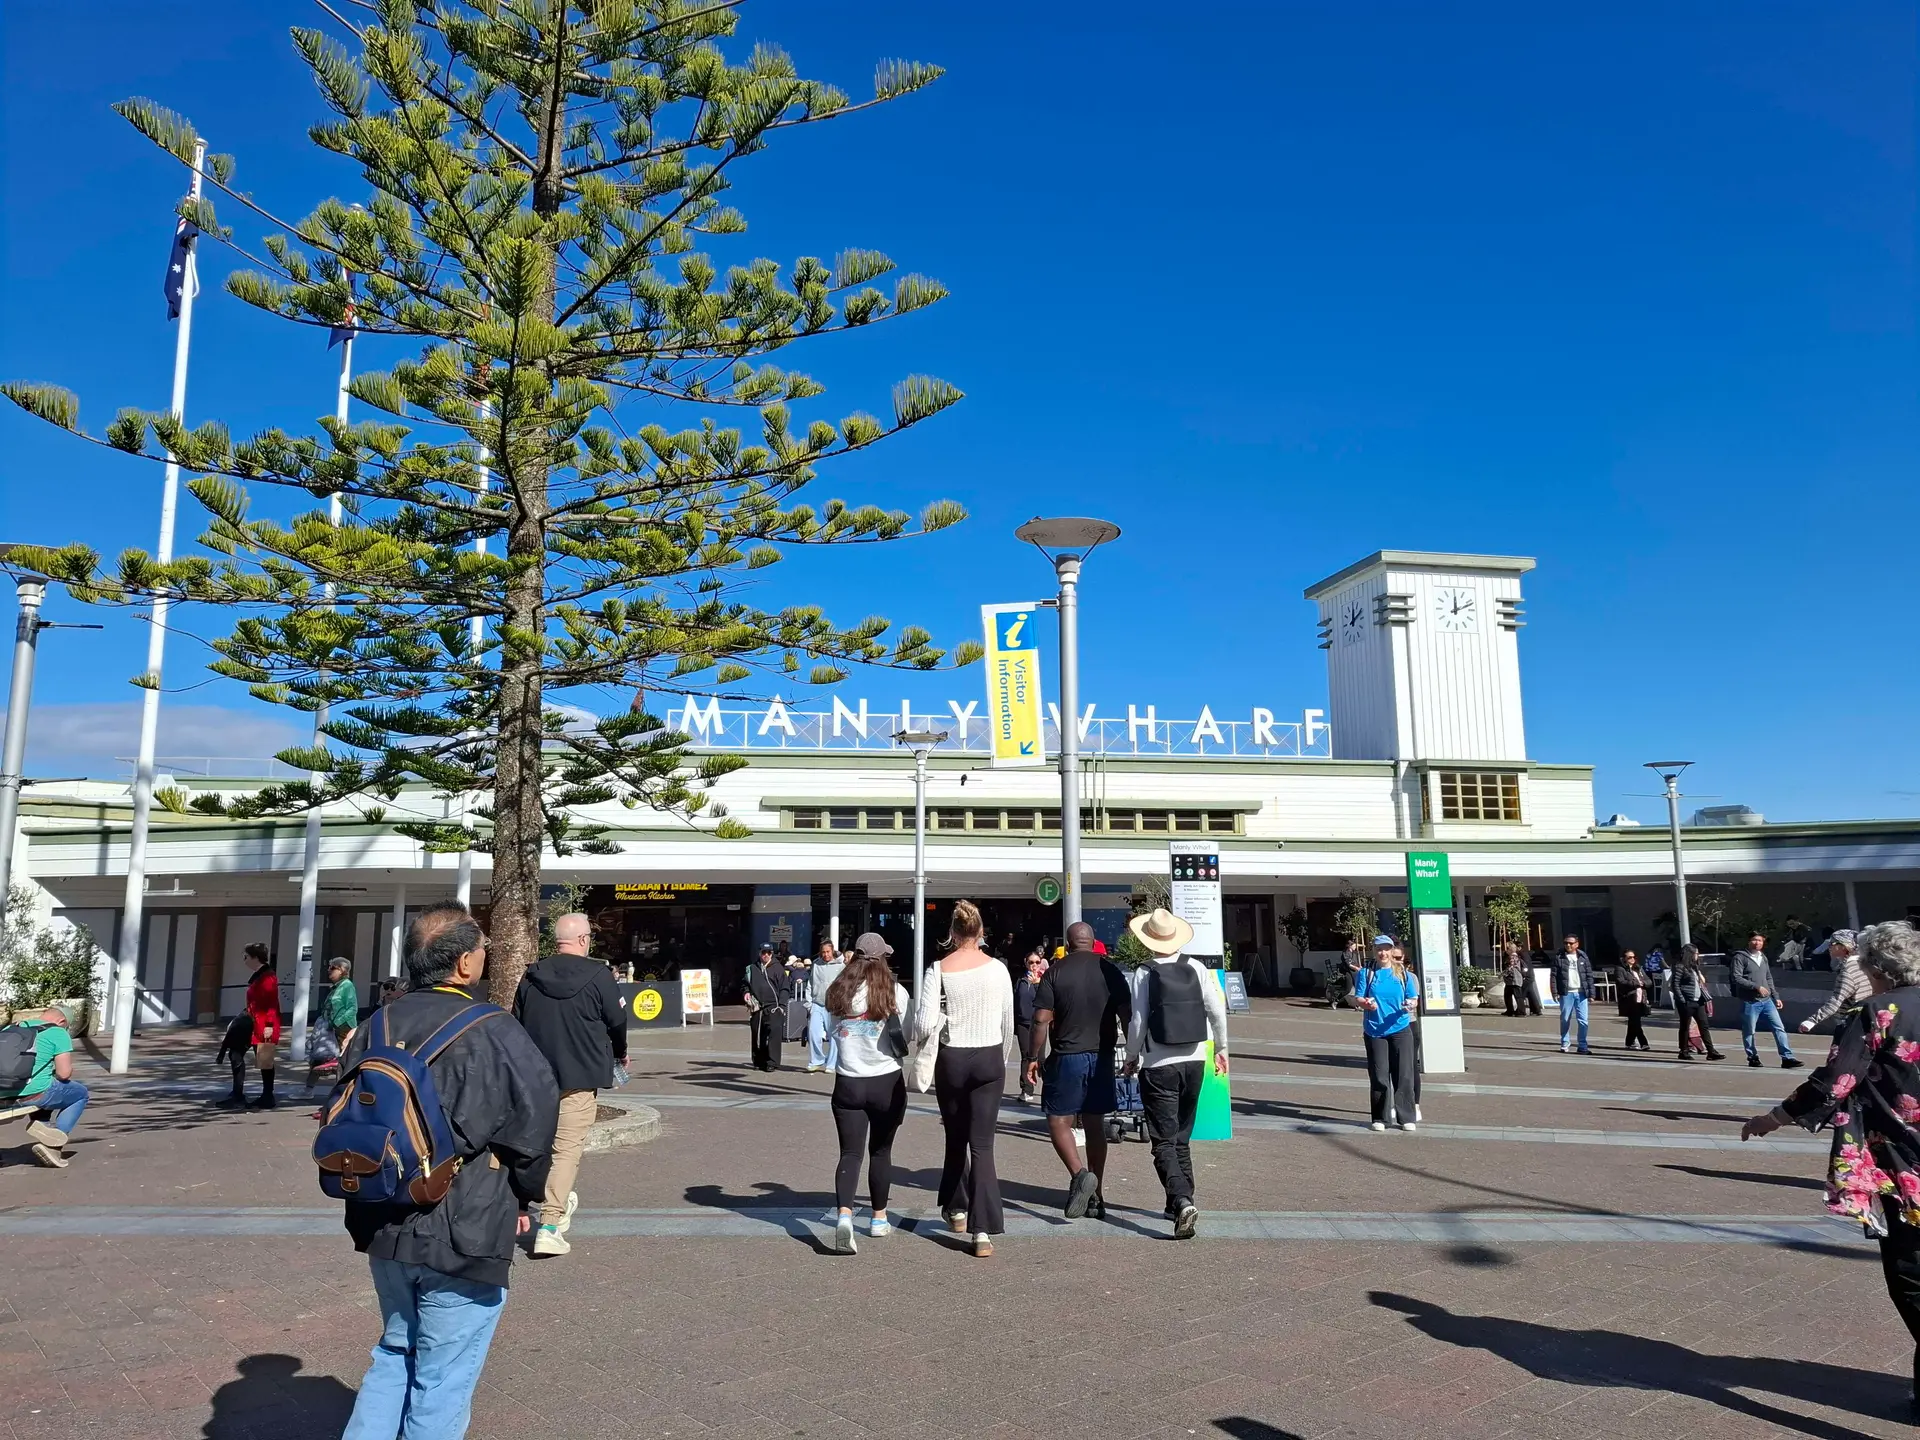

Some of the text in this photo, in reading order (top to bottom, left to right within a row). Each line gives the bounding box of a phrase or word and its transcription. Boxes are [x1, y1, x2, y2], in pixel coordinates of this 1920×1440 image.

[1014, 659, 1027, 705] Visitor
[998, 659, 1014, 740] Information
[679, 692, 1324, 746] MANLY WHARF
[1414, 859, 1438, 869] Manly
[1415, 869, 1440, 878] Wharf
[615, 891, 675, 900] Mexican Kitchen
[1045, 884, 1053, 897] F
